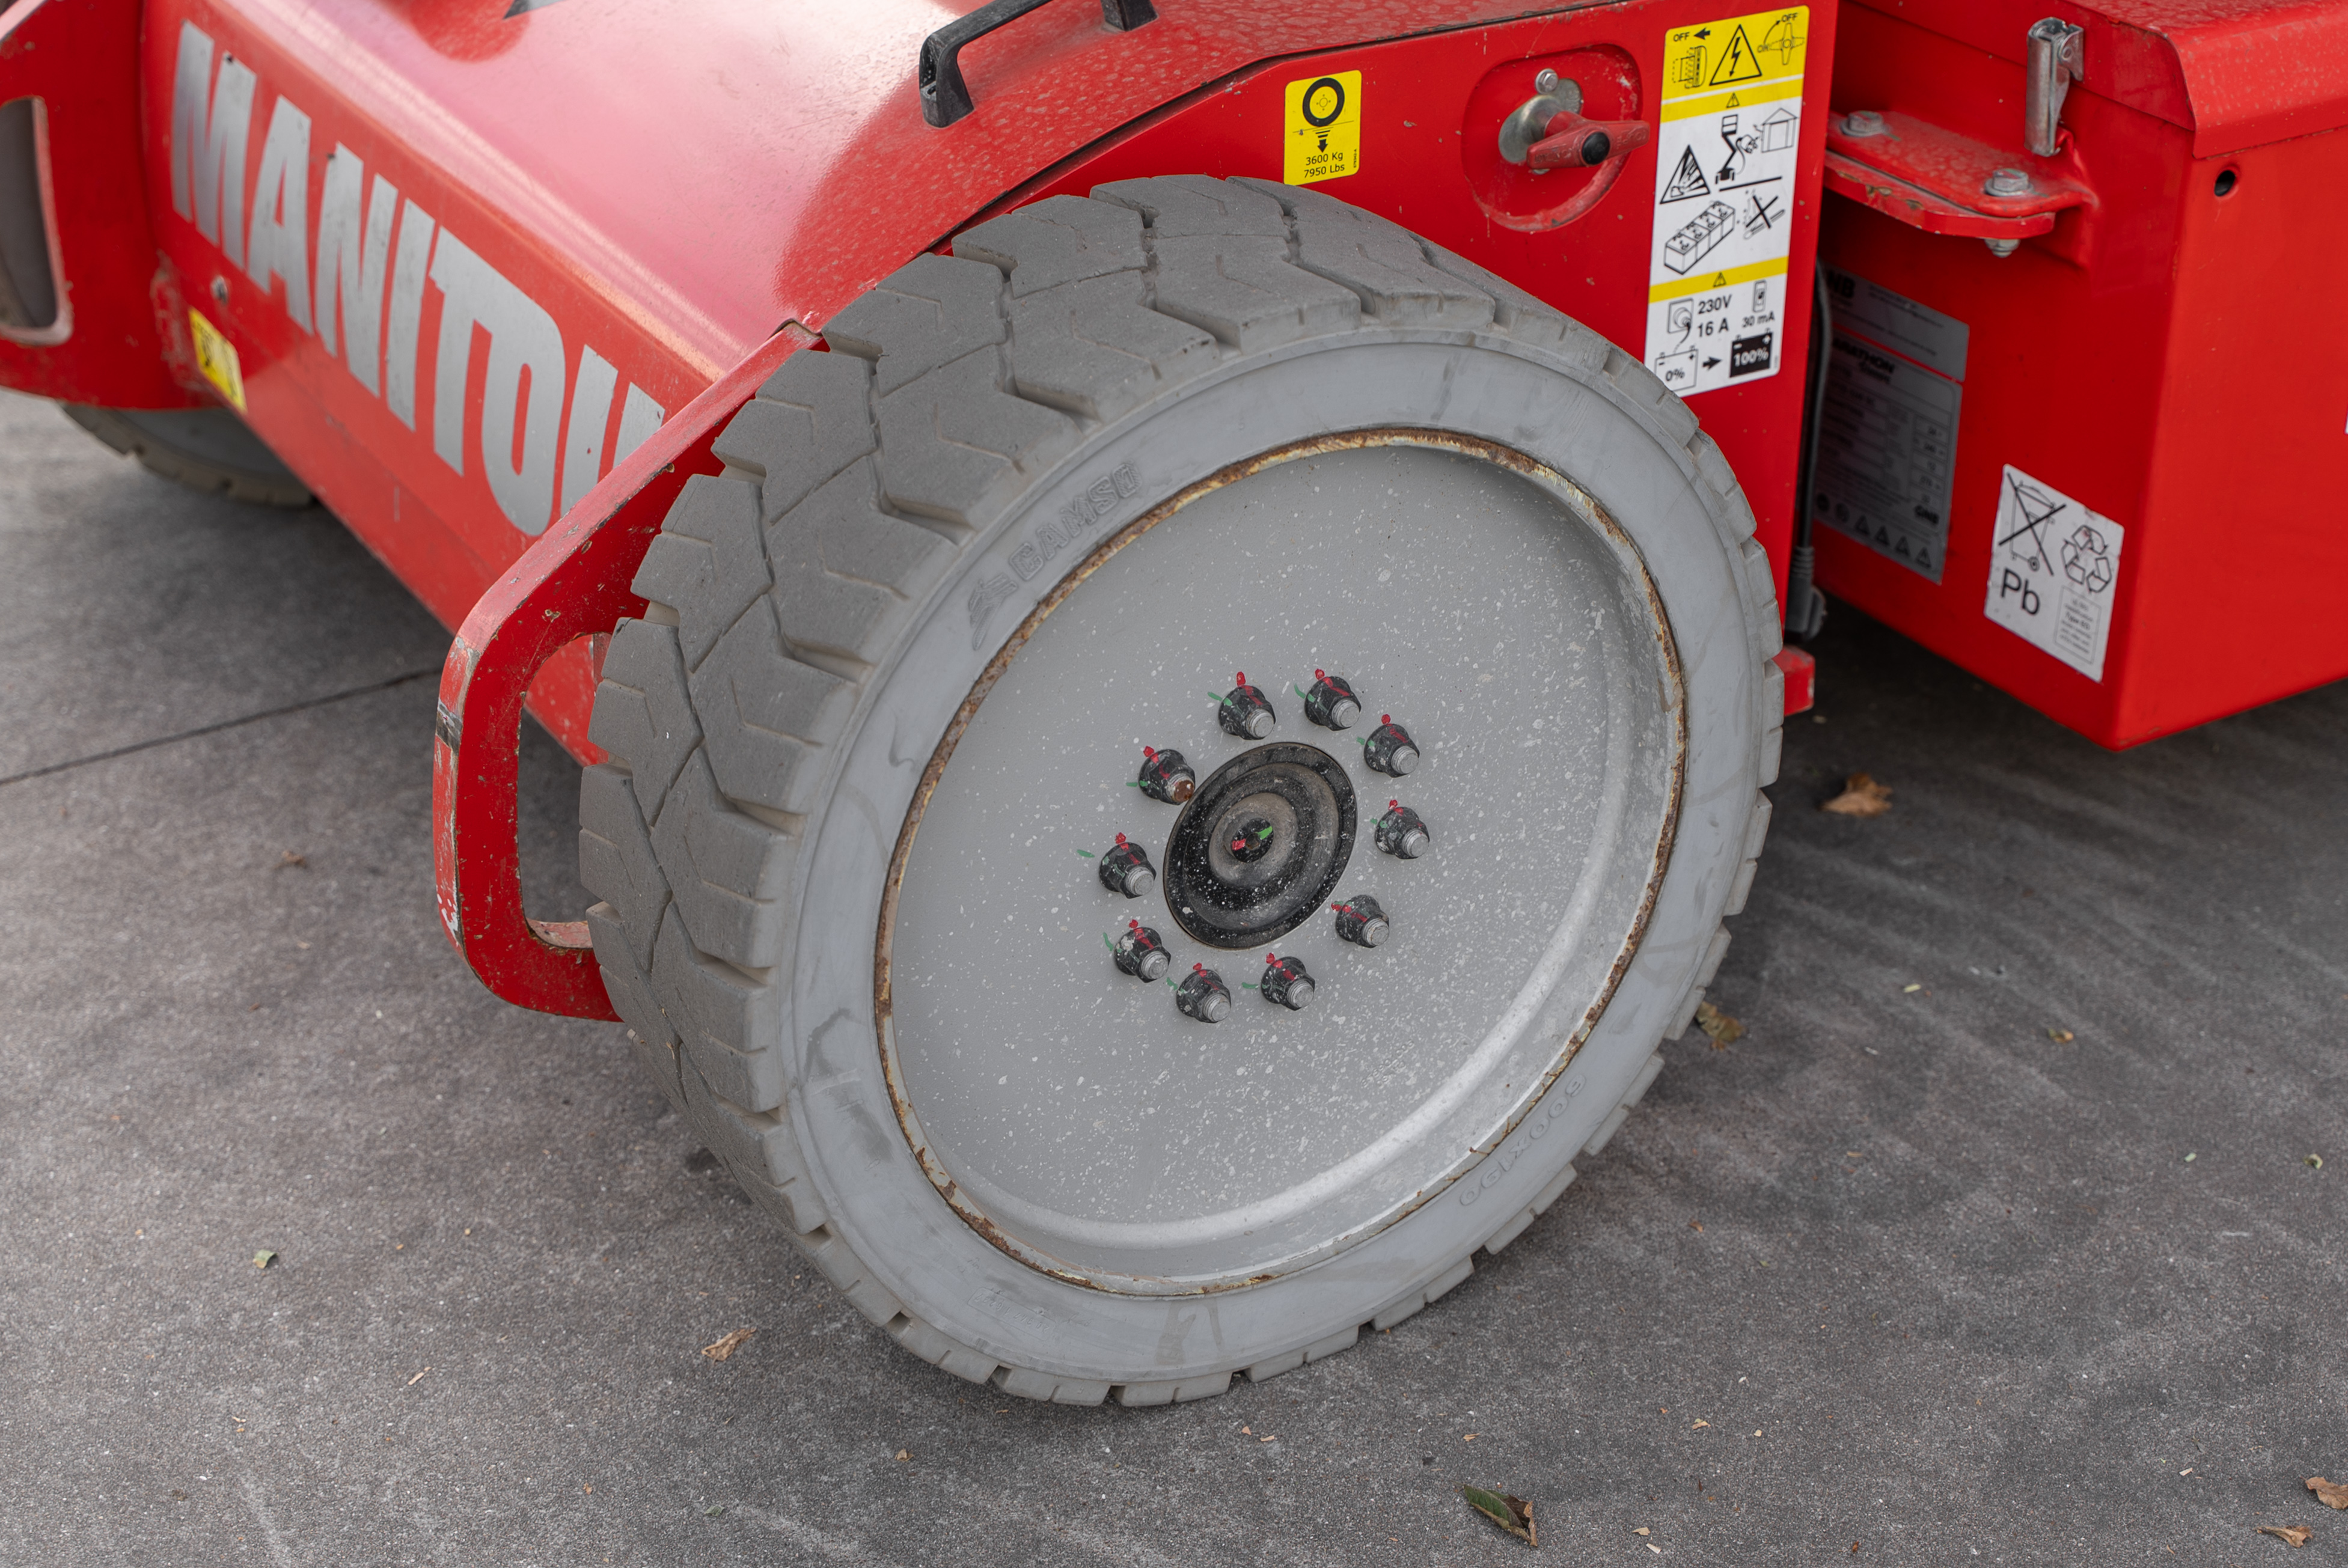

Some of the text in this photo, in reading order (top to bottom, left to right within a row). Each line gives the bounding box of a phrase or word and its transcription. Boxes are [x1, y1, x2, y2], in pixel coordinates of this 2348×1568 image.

[1781, 12, 1799, 22] OFF
[1673, 31, 1690, 42] OFF
[1757, 44, 1769, 53] ON
[1305, 153, 1328, 166] 3600
[1331, 151, 1344, 162] Kg
[1303, 163, 1345, 178] 7950 Lbs
[1698, 293, 1732, 314] 230V
[1698, 317, 1729, 337] 16 A
[1742, 311, 1775, 328] 30 mA
[1733, 347, 1769, 367] 100%
[1665, 368, 1685, 382] 0%
[1008, 459, 1142, 581] CAMSO
[2000, 568, 2040, 615] Pb
